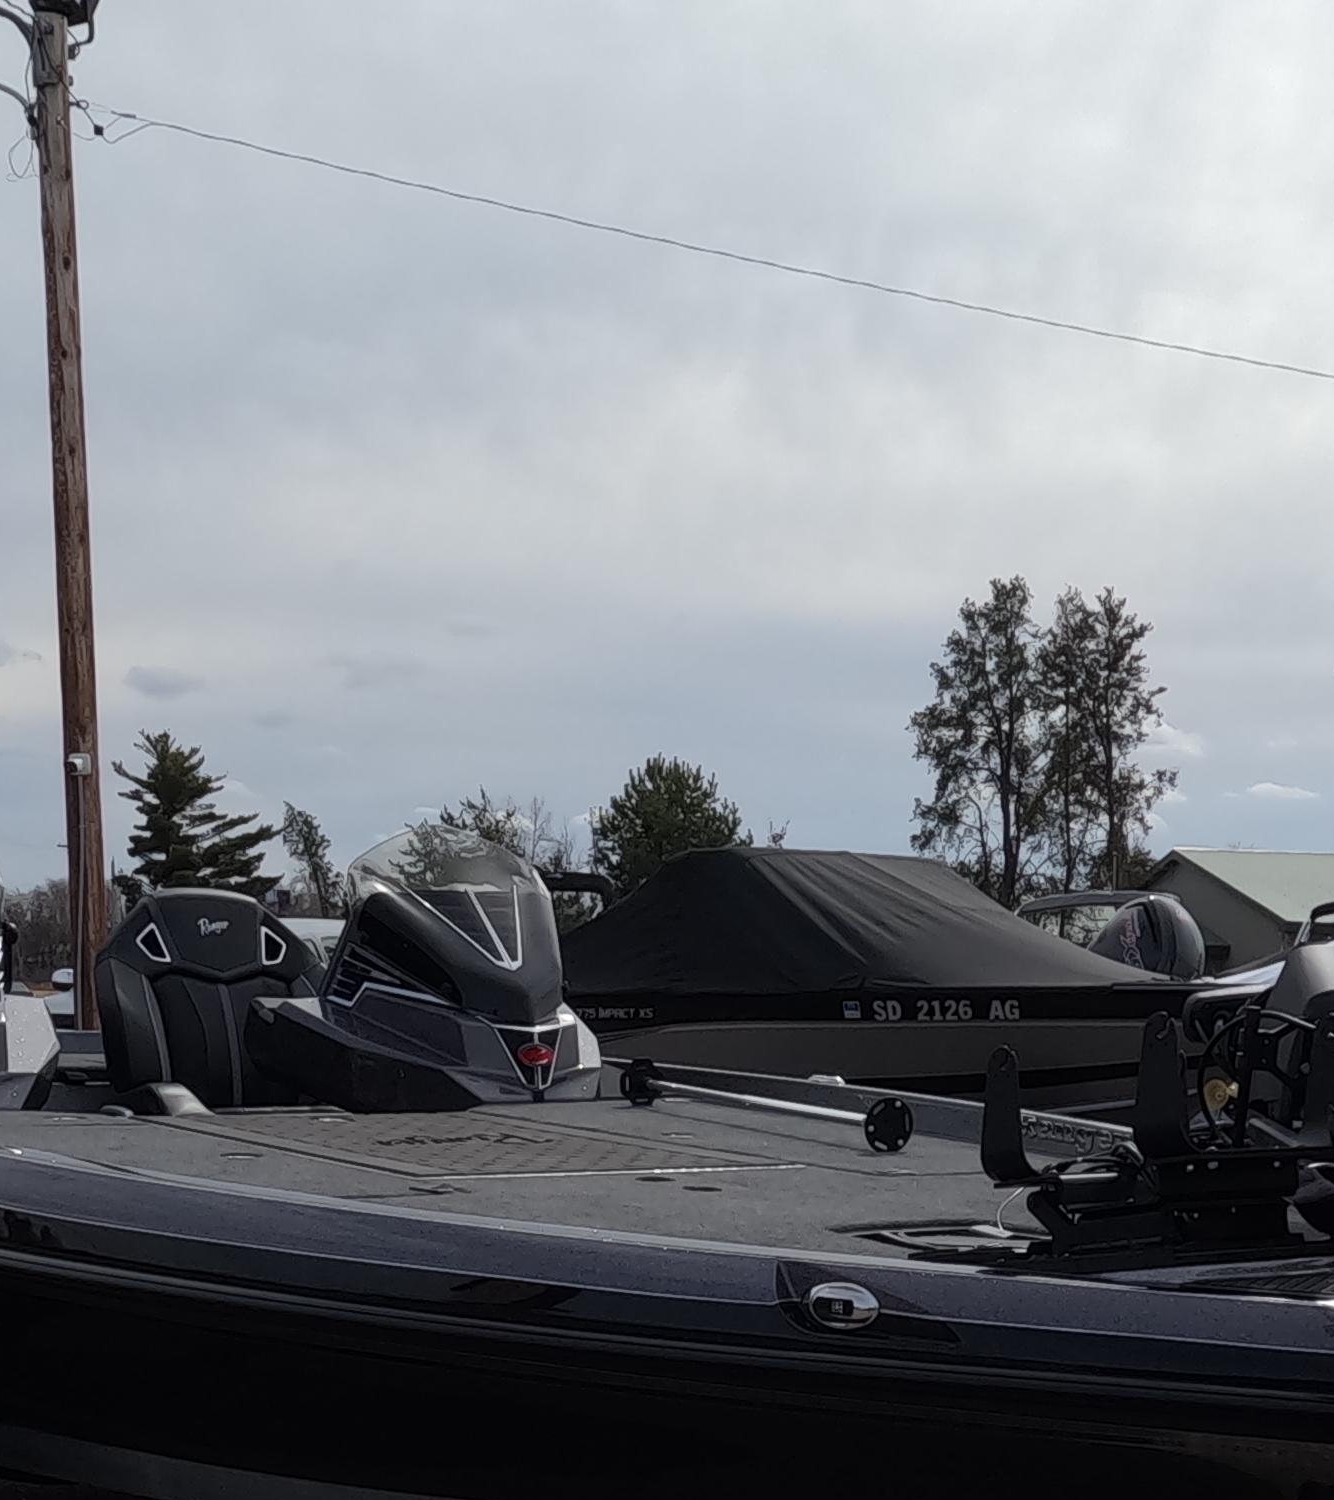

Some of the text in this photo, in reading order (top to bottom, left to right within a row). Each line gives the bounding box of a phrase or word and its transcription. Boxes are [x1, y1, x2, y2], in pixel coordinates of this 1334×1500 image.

[598, 1007, 636, 1019] IMPACT
[638, 1007, 655, 1019] XS
[872, 999, 903, 1021] SD
[916, 999, 973, 1021] 2126
[989, 999, 1020, 1021] AG
